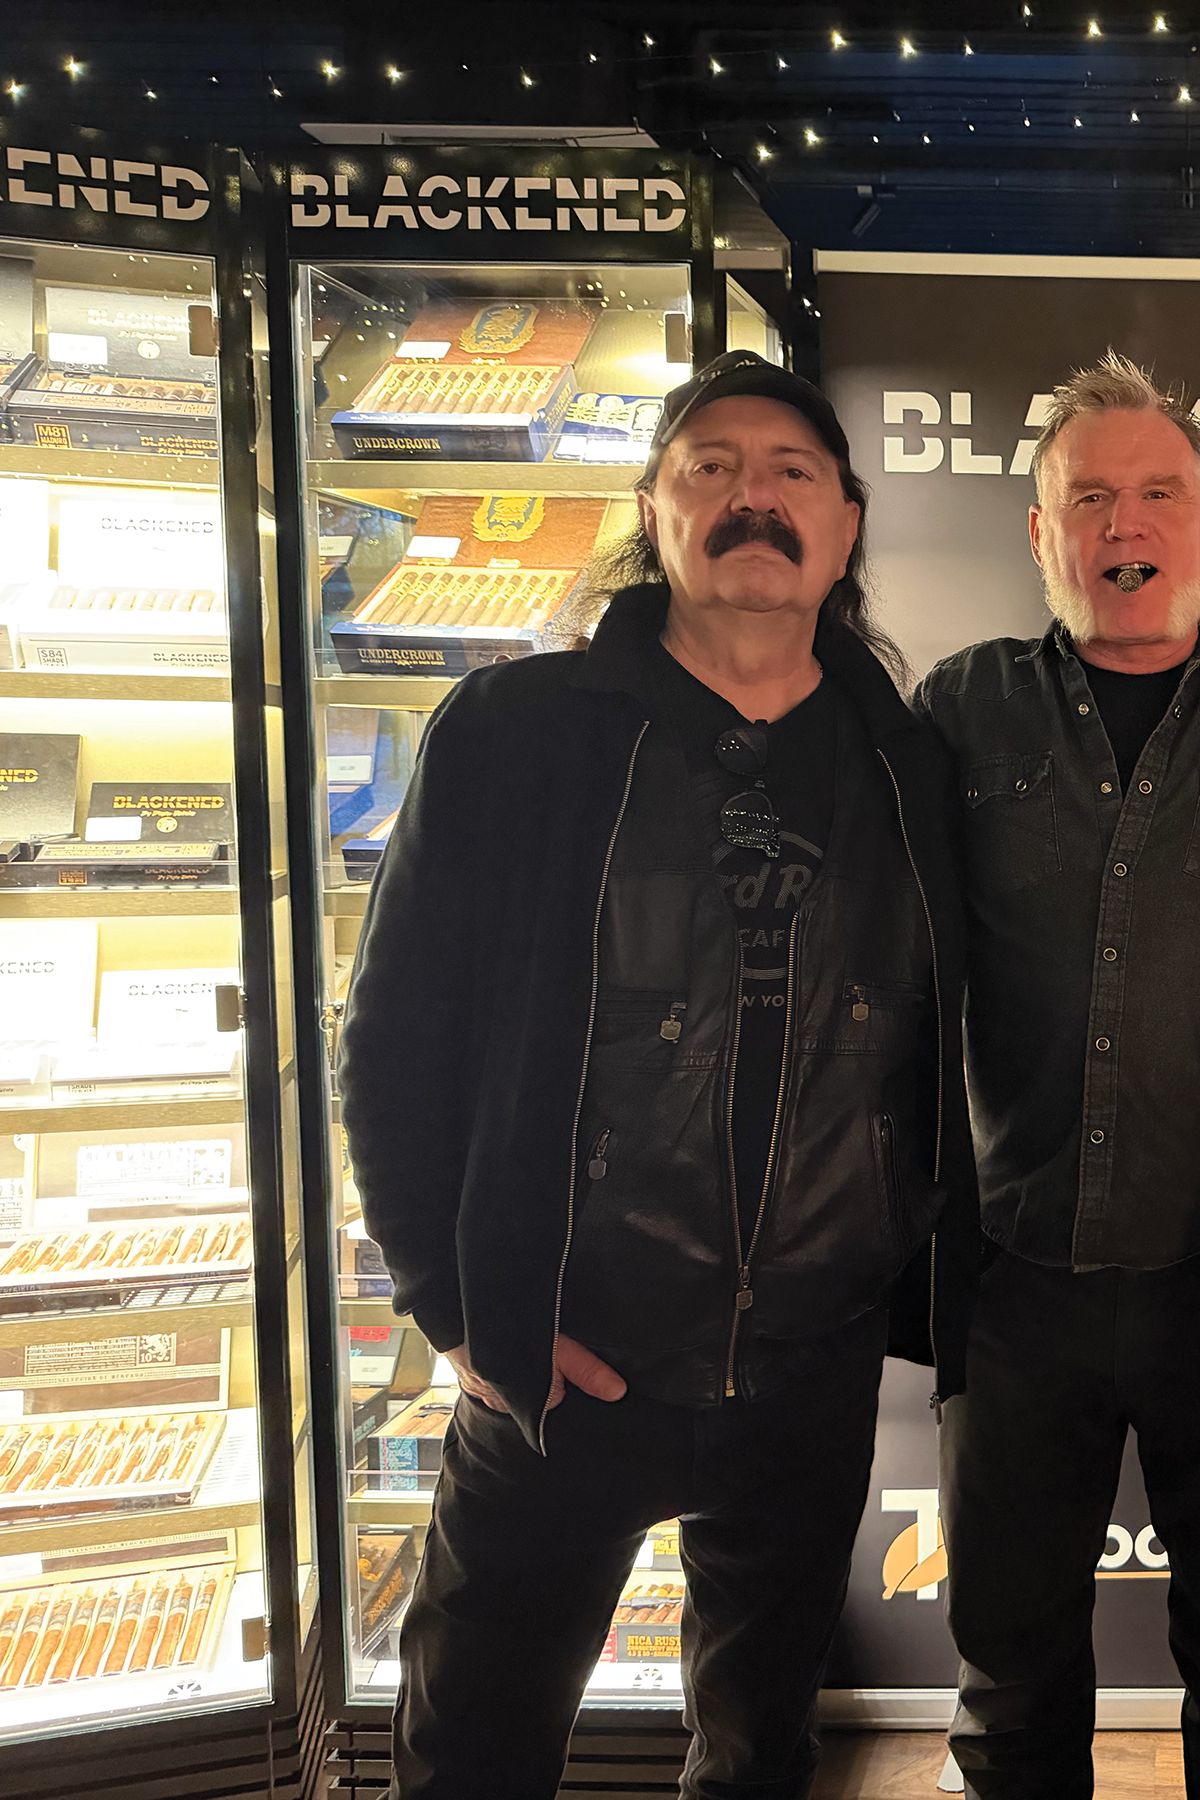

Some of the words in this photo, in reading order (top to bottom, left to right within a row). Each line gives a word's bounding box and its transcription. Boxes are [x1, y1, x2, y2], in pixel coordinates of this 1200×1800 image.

[0, 147, 210, 221] ENED
[290, 174, 687, 233] BLACKENED
[38, 425, 67, 438] M81
[140, 435, 218, 451] BLACKENED
[353, 437, 441, 452] UNDERCROWN
[101, 517, 214, 534] BLACKENED
[41, 649, 63, 658] S84
[153, 652, 230, 663] BLACKENED
[358, 648, 444, 662] UNDERCROWN
[112, 795, 226, 809] BLACKENED
[627, 1635, 652, 1645] NICA
